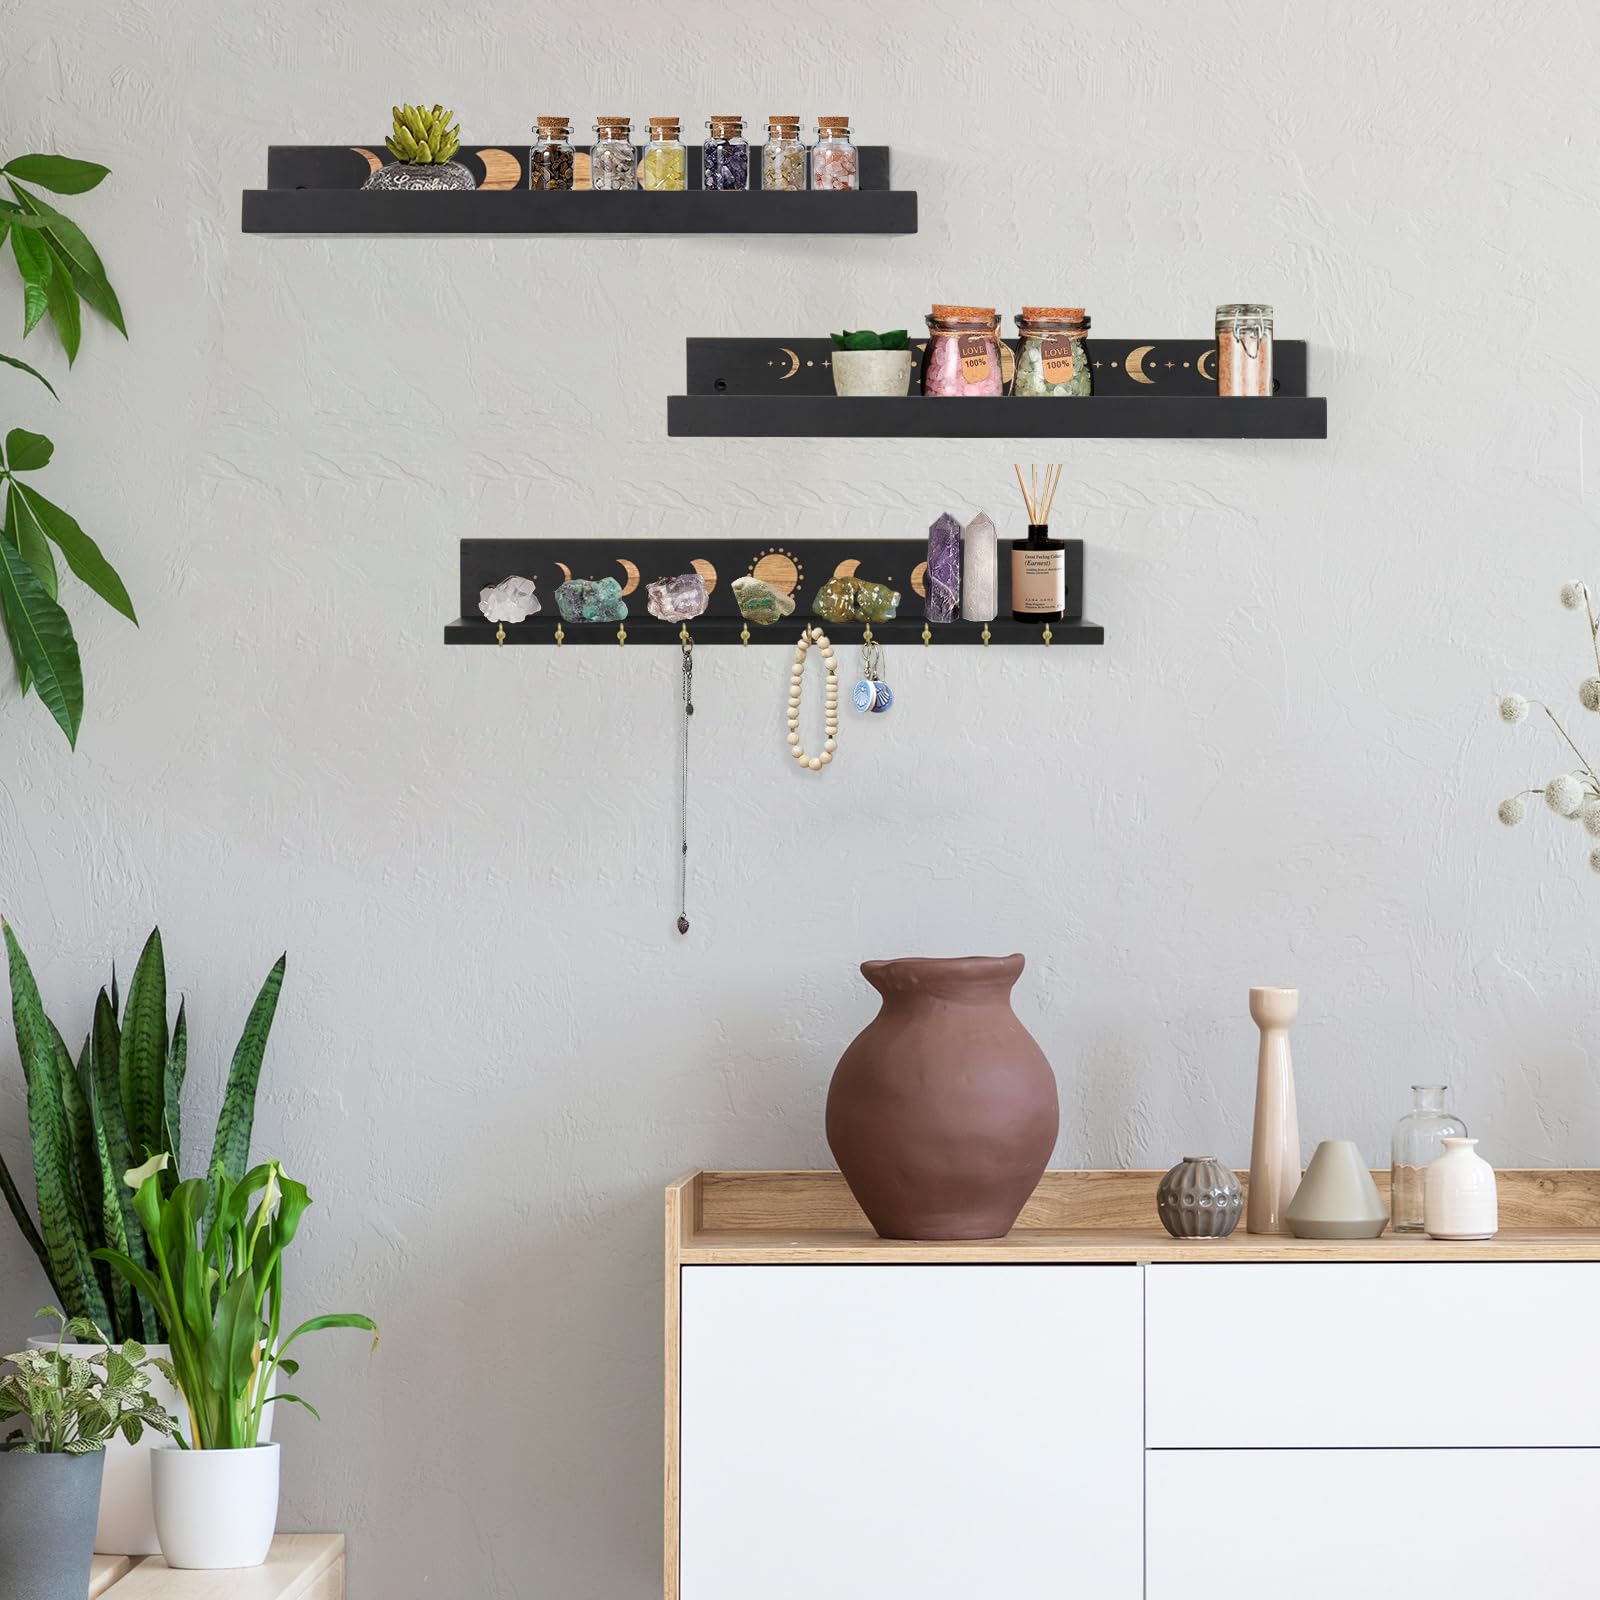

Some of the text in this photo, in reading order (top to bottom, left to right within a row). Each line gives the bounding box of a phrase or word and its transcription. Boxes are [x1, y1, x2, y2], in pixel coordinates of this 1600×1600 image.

[962, 345, 985, 356] LOVE
[1044, 347, 1069, 357] LOVE
[965, 357, 987, 368] 100%
[1046, 360, 1070, 369] 100%
